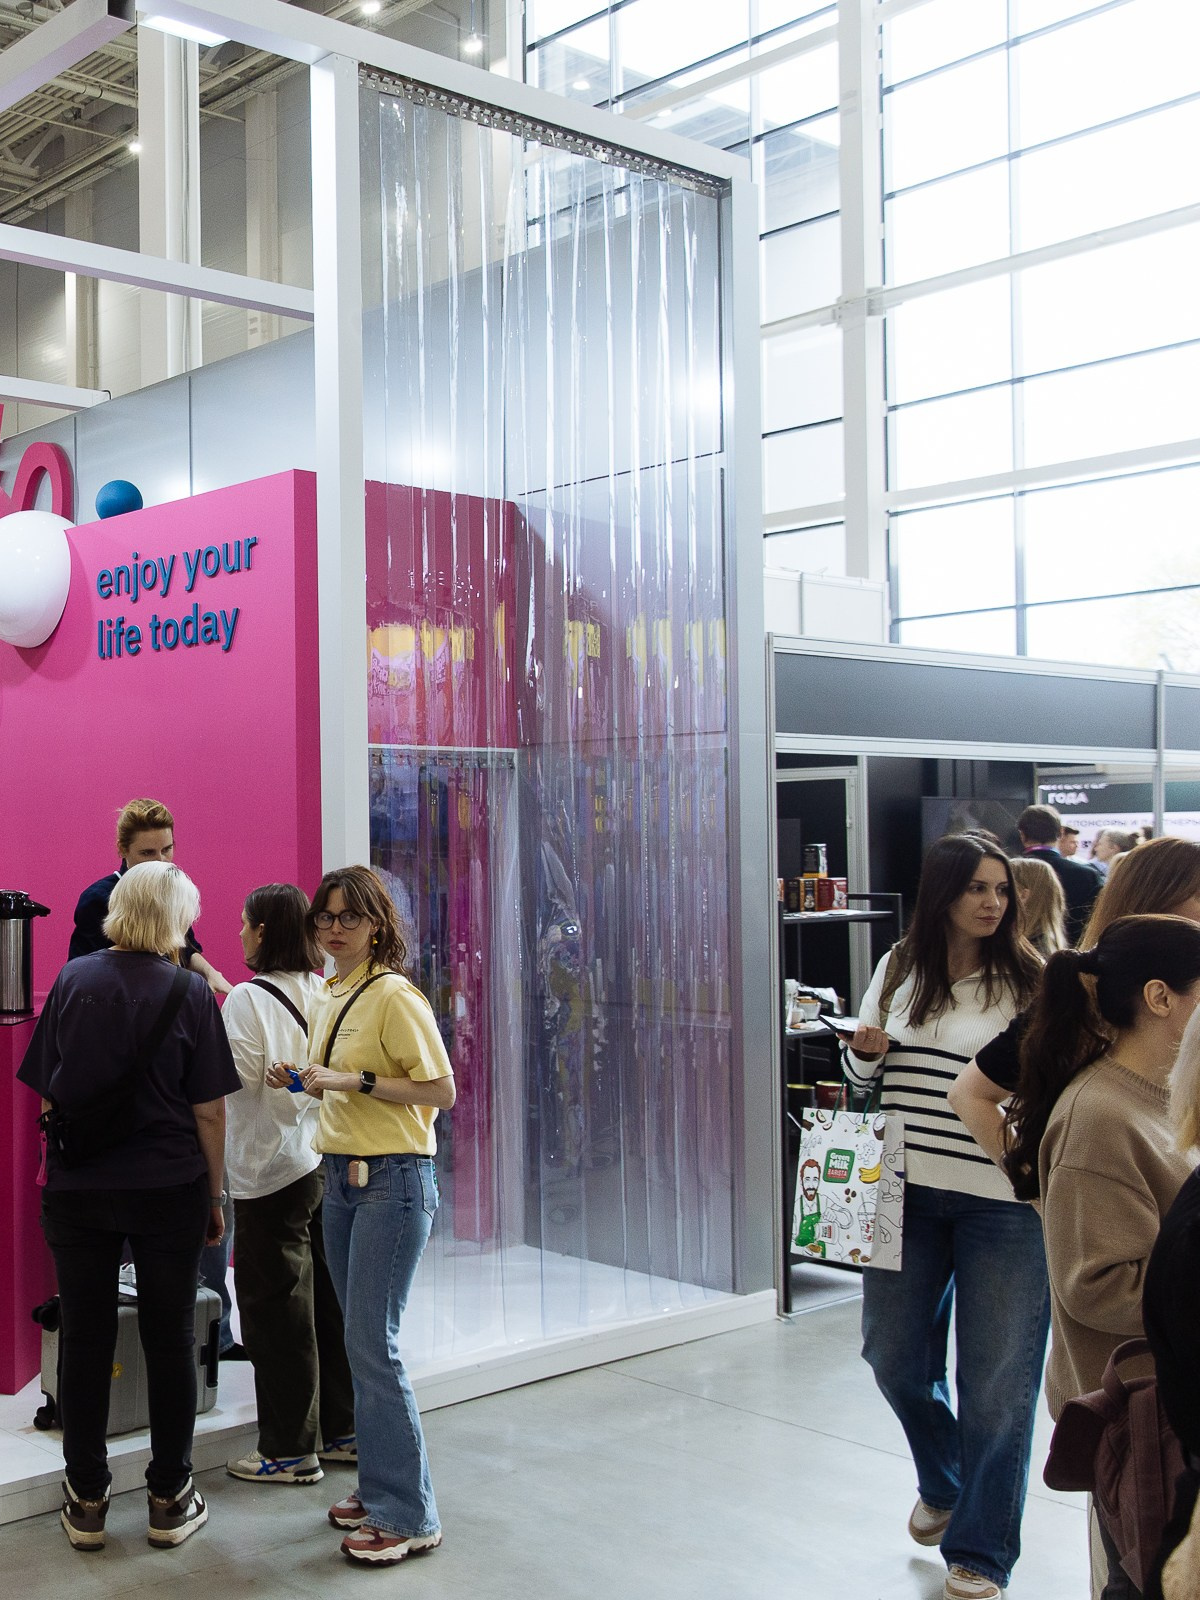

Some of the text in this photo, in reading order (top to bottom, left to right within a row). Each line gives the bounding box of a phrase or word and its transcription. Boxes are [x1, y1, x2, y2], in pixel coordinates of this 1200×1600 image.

[96, 536, 259, 603] enjoy your
[97, 602, 240, 660] life today
[1047, 791, 1089, 805] ГОДА
[830, 1152, 850, 1162] Green
[829, 1159, 849, 1170] Milk
